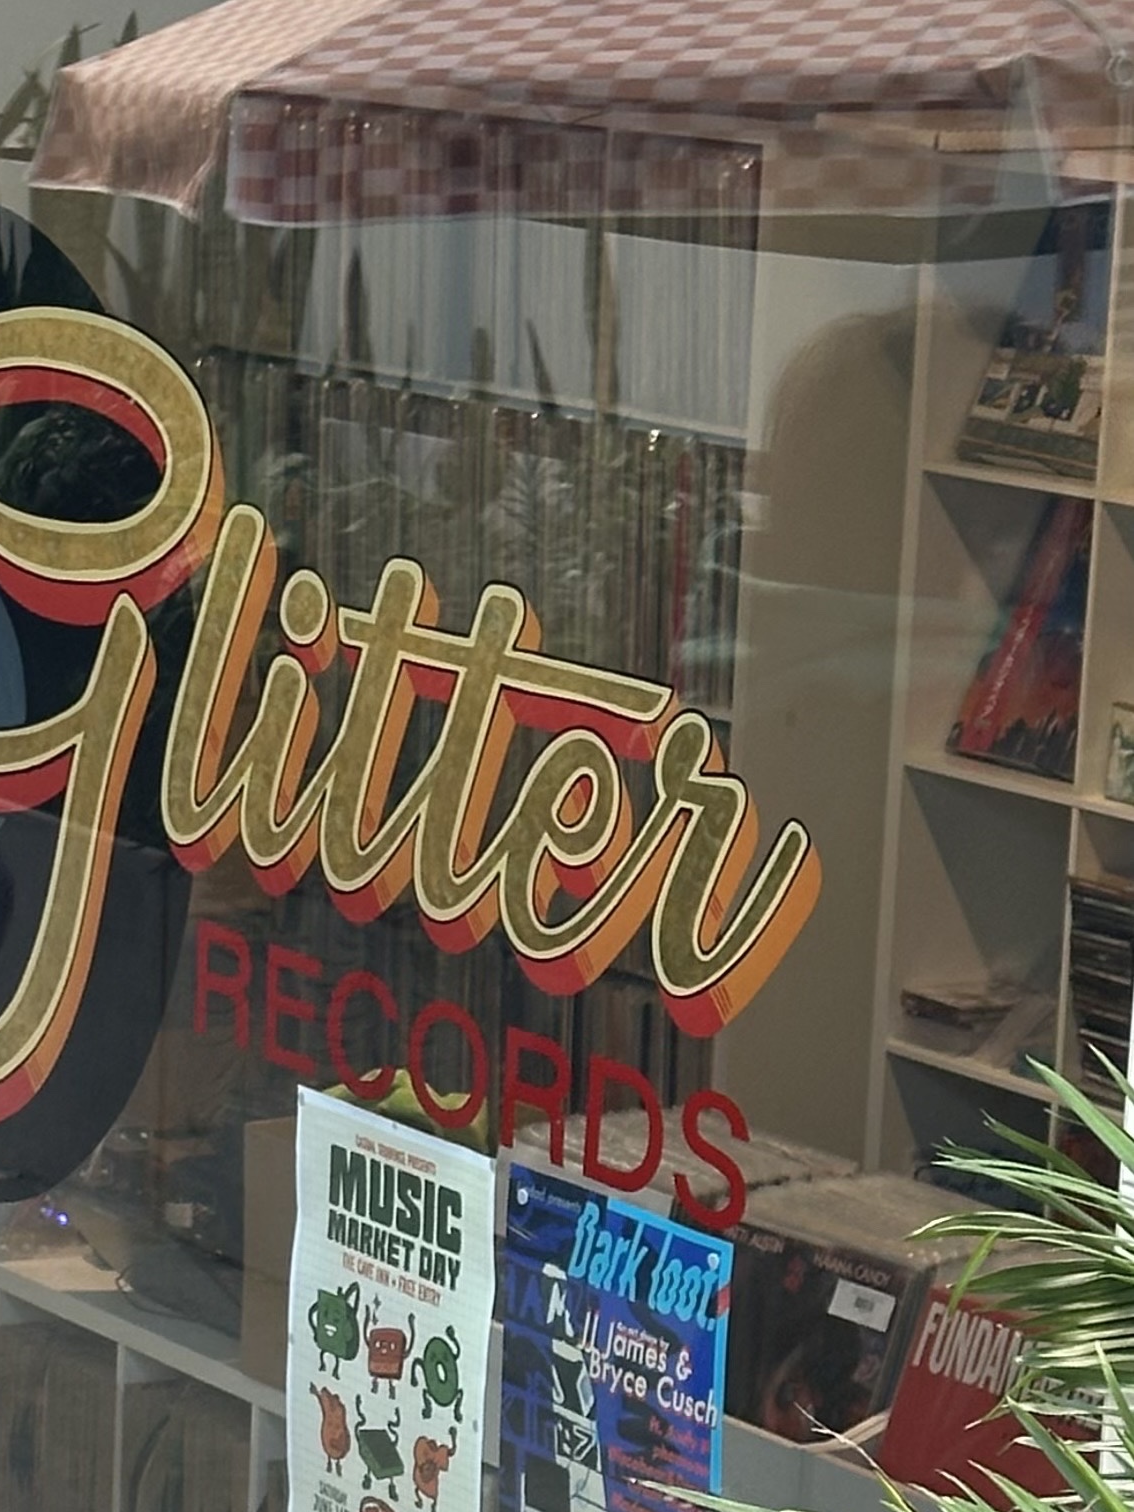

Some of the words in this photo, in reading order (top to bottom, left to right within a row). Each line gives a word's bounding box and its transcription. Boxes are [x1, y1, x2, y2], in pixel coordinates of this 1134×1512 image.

[195, 920, 750, 1230] RECORDS
[328, 1143, 463, 1256] MUSIC
[327, 1208, 416, 1273] MARKET
[419, 1246, 462, 1292] DAY
[568, 1200, 649, 1303] Dark
[589, 1348, 648, 1399] Bryce
[656, 1375, 718, 1428] Cusch
[601, 1320, 668, 1373] James
[674, 1347, 693, 1381] &
